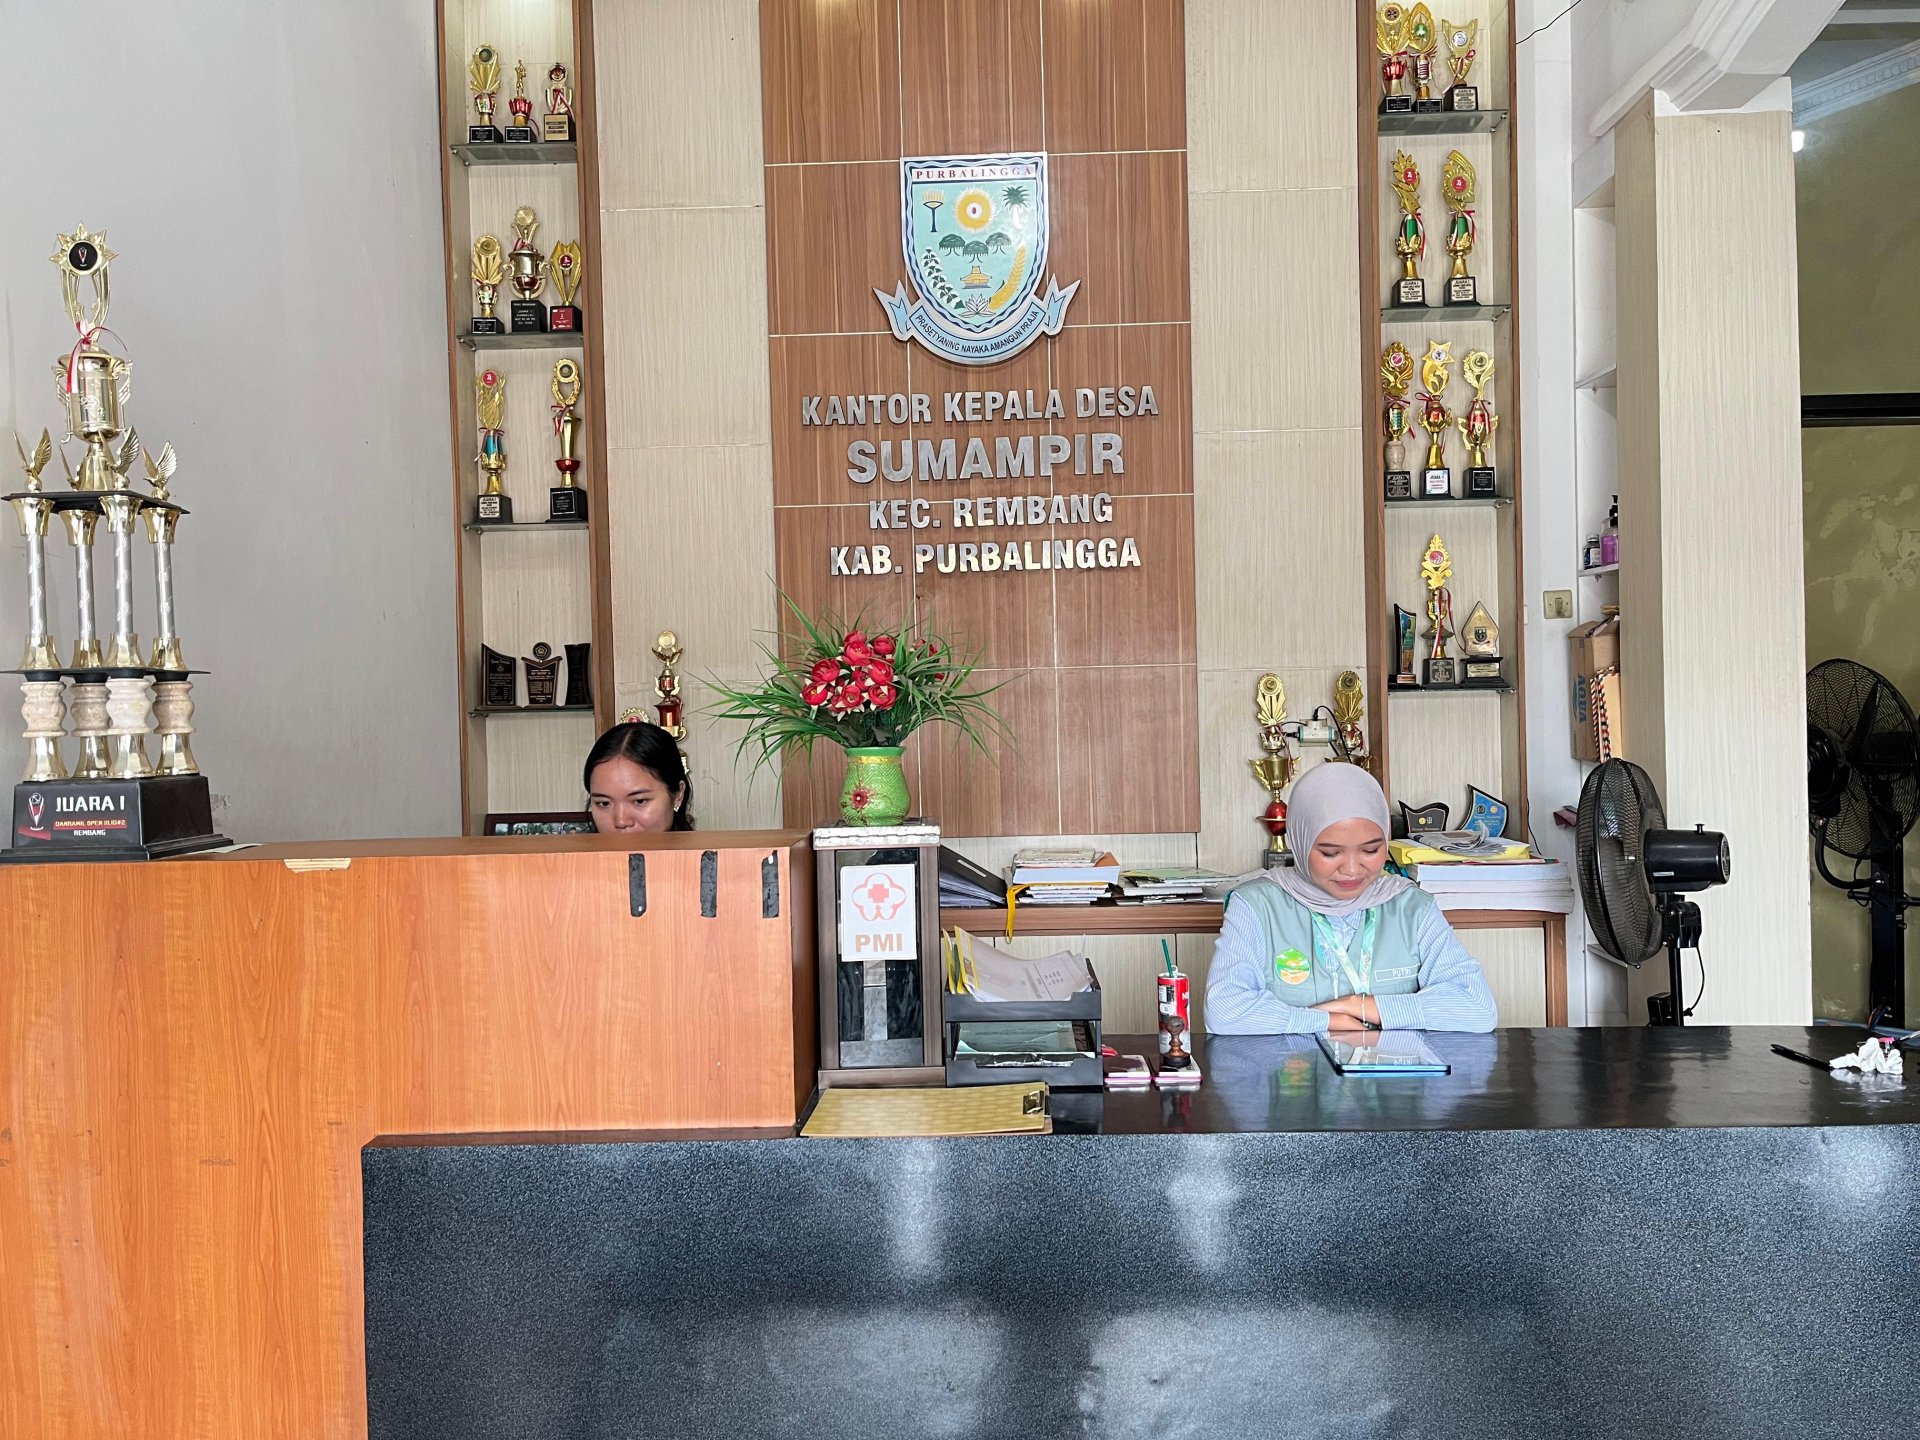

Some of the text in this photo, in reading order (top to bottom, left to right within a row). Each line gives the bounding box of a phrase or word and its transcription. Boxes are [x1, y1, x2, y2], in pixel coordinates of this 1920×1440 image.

[916, 167, 1032, 180] PURBALINGGA
[915, 310, 1040, 353] PRASETYANING NAYAKA AMANGUN PRAJA
[802, 385, 1159, 425] KANTOR KEPALA DESA
[847, 433, 1125, 483] SUMAMPIR
[869, 493, 1113, 529] KEC. REMBANG
[830, 537, 1141, 576] KAB. PURBALINGGA
[1577, 674, 1586, 722] AQUA
[55, 795, 115, 812] JUARA
[855, 933, 903, 952] PMI
